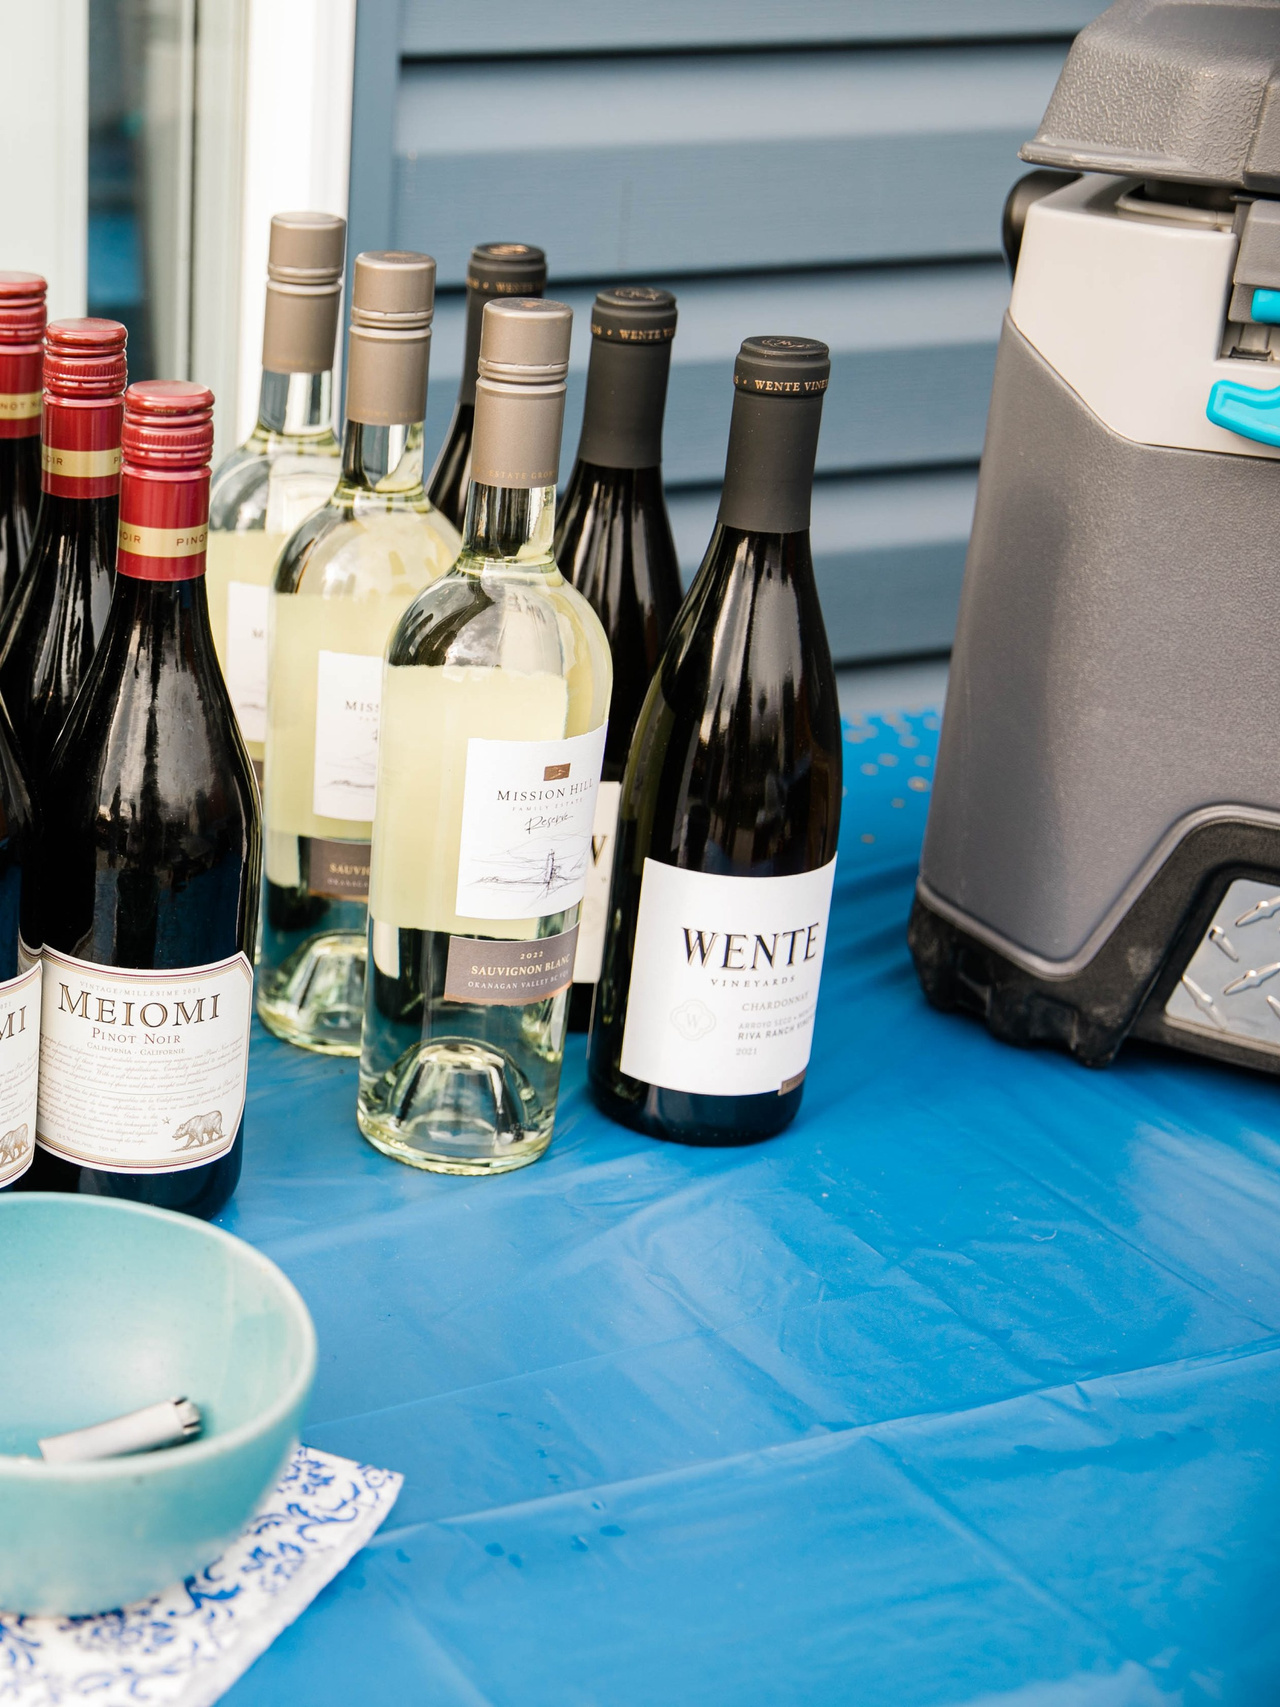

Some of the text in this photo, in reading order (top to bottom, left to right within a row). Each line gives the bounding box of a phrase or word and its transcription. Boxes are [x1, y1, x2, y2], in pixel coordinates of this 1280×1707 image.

[619, 329, 661, 341] WENTE
[754, 379, 801, 392] WENTE
[43, 454, 64, 466] OIR
[345, 700, 379, 713] MISS
[497, 778, 593, 802] MISSION HILL
[524, 812, 574, 834] Reserve
[681, 922, 819, 972] WENTE
[519, 950, 544, 960] 2022
[471, 953, 571, 977] SAUVIGNON BLANC
[467, 980, 518, 990] OKANAGAN
[521, 977, 549, 988] VALLEY
[710, 975, 796, 988] VINEYARDS
[58, 982, 221, 1028] MEIOMI
[741, 991, 810, 1012] CHARDONNAY
[91, 1027, 181, 1045] PINOT NOIR
[737, 1032, 762, 1041] RIVA
[86, 1041, 186, 1056] CALIFORNIA CALIFORNIE
[735, 1047, 758, 1056] 2021
